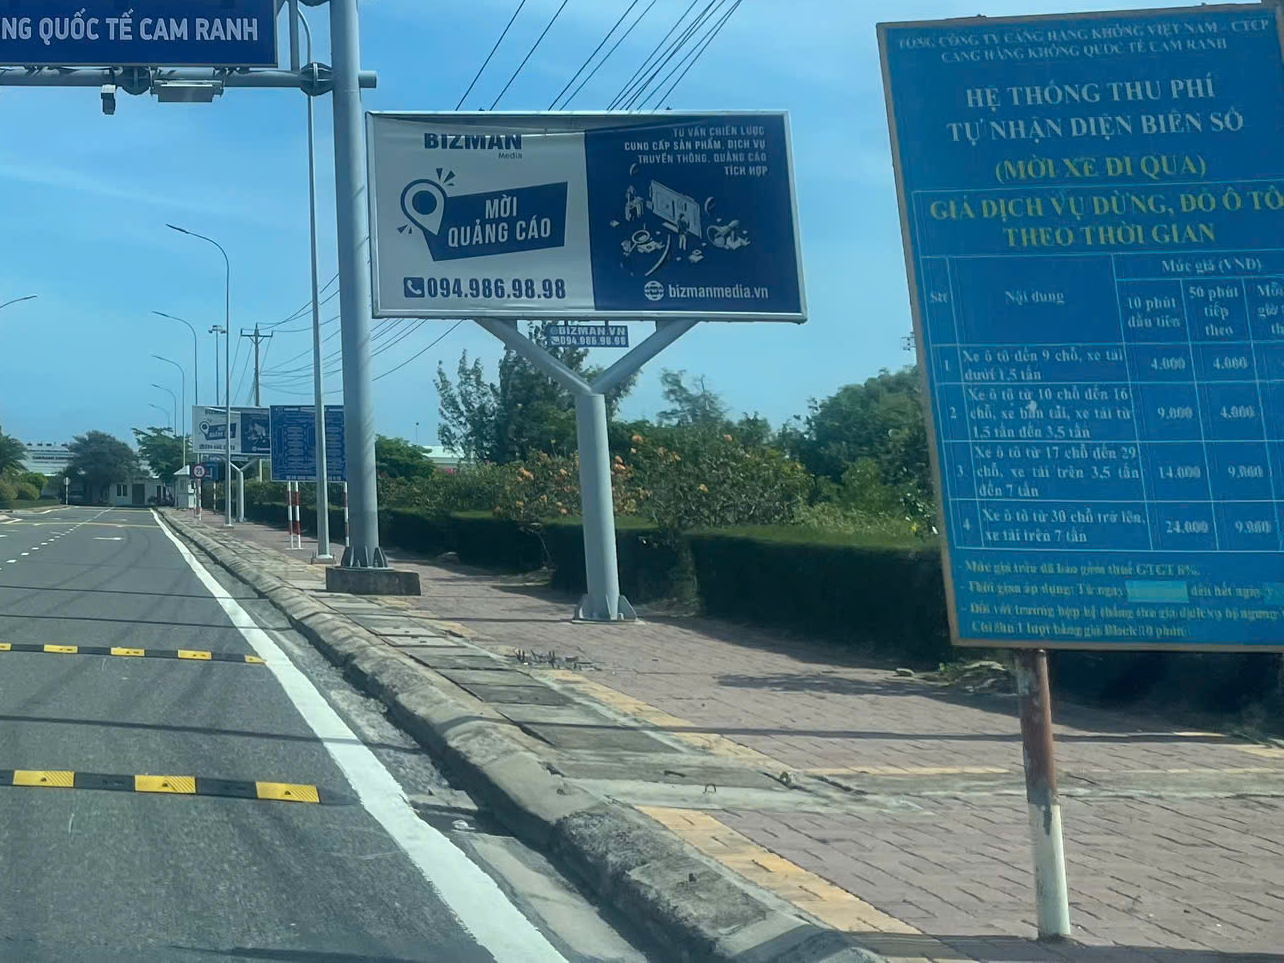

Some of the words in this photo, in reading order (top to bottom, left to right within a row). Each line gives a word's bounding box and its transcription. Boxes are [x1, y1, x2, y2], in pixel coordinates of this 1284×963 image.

[39, 8, 99, 45] QUỐC
[106, 8, 134, 41] TẾ
[139, 17, 188, 41] CAM
[195, 17, 258, 41] RANH
[1107, 81, 1161, 102] THU
[1170, 71, 1215, 99] PHÍ
[424, 132, 522, 150] BIZMAN
[1062, 156, 1100, 178] XE
[1139, 154, 1207, 180] QUA)
[485, 194, 517, 219] MỜI
[930, 195, 975, 220] GIÁ
[981, 197, 1044, 222] DỊCH
[1222, 187, 1242, 212] Ô
[448, 219, 509, 247] QUẢNG
[516, 215, 551, 241] CÁO
[1003, 227, 1074, 247] THEO
[1151, 223, 1215, 245] GIAN
[427, 277, 566, 299] 094.986.98.98
[668, 284, 769, 299] bizmanmedia.vn
[559, 326, 626, 336] BIZMAN.VN
[949, 407, 957, 419] 2
